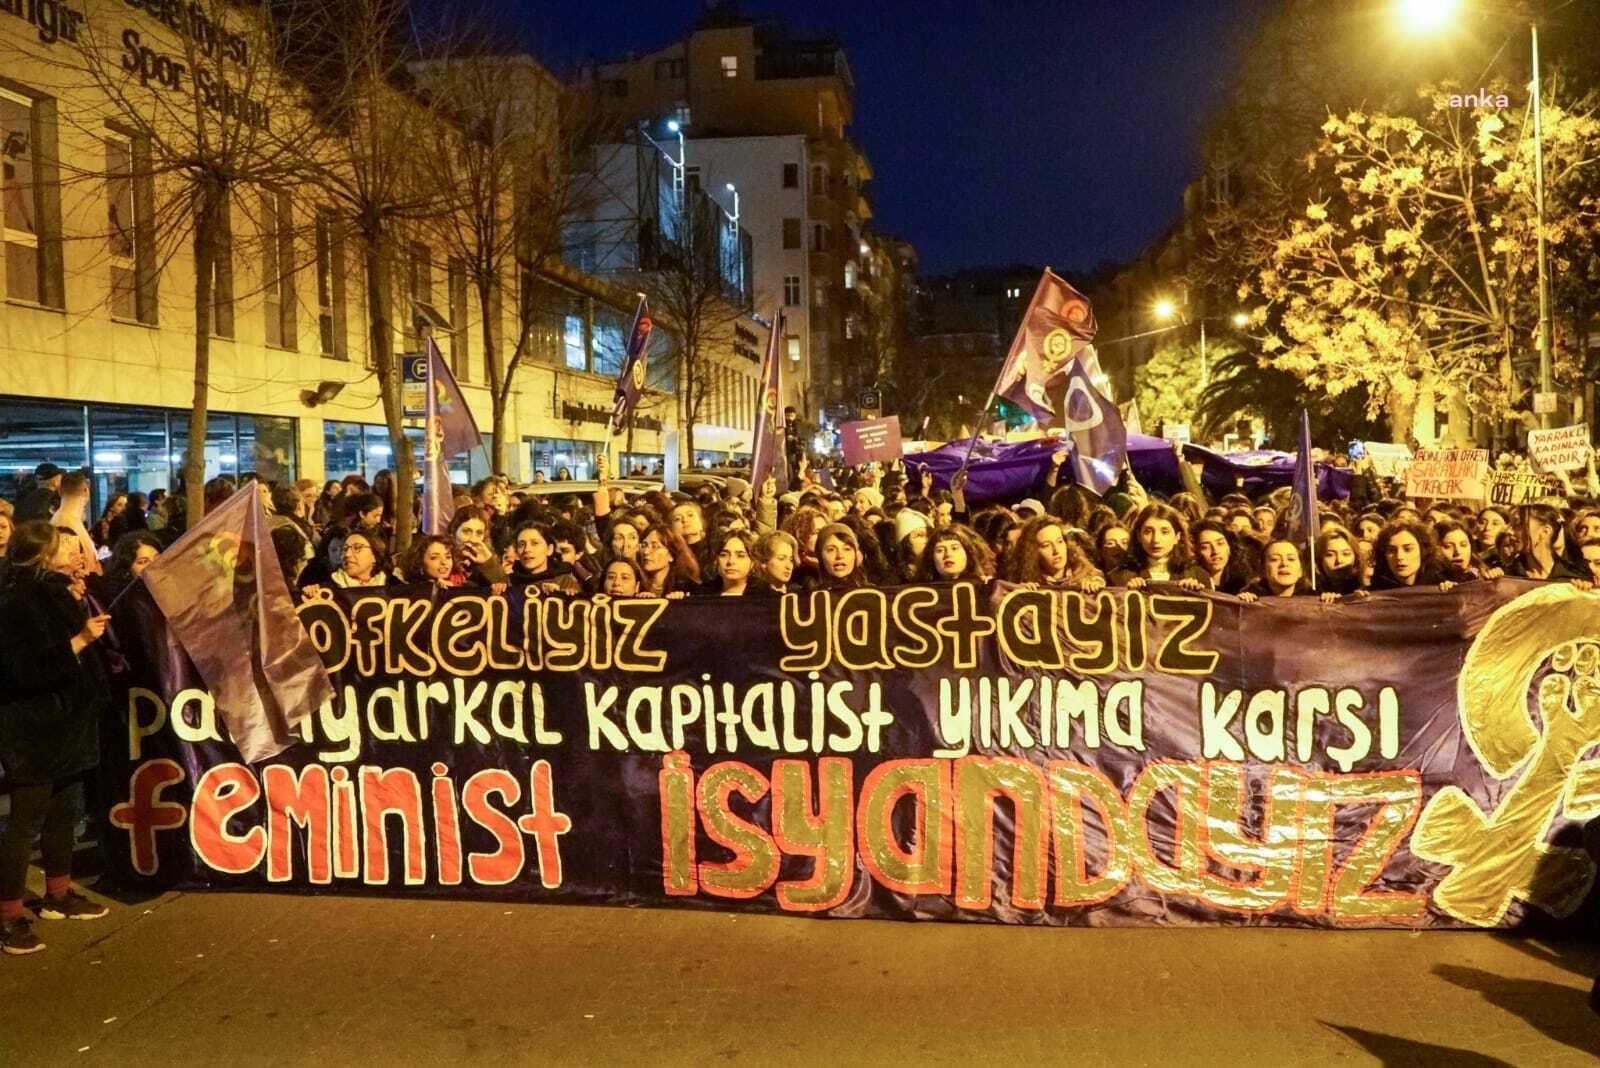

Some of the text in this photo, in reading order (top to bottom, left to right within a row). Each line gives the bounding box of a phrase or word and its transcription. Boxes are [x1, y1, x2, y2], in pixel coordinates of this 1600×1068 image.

[121, 28, 186, 91] Spor
[1534, 450, 1581, 468] VARDIR
[1412, 479, 1463, 495] YIKACAK
